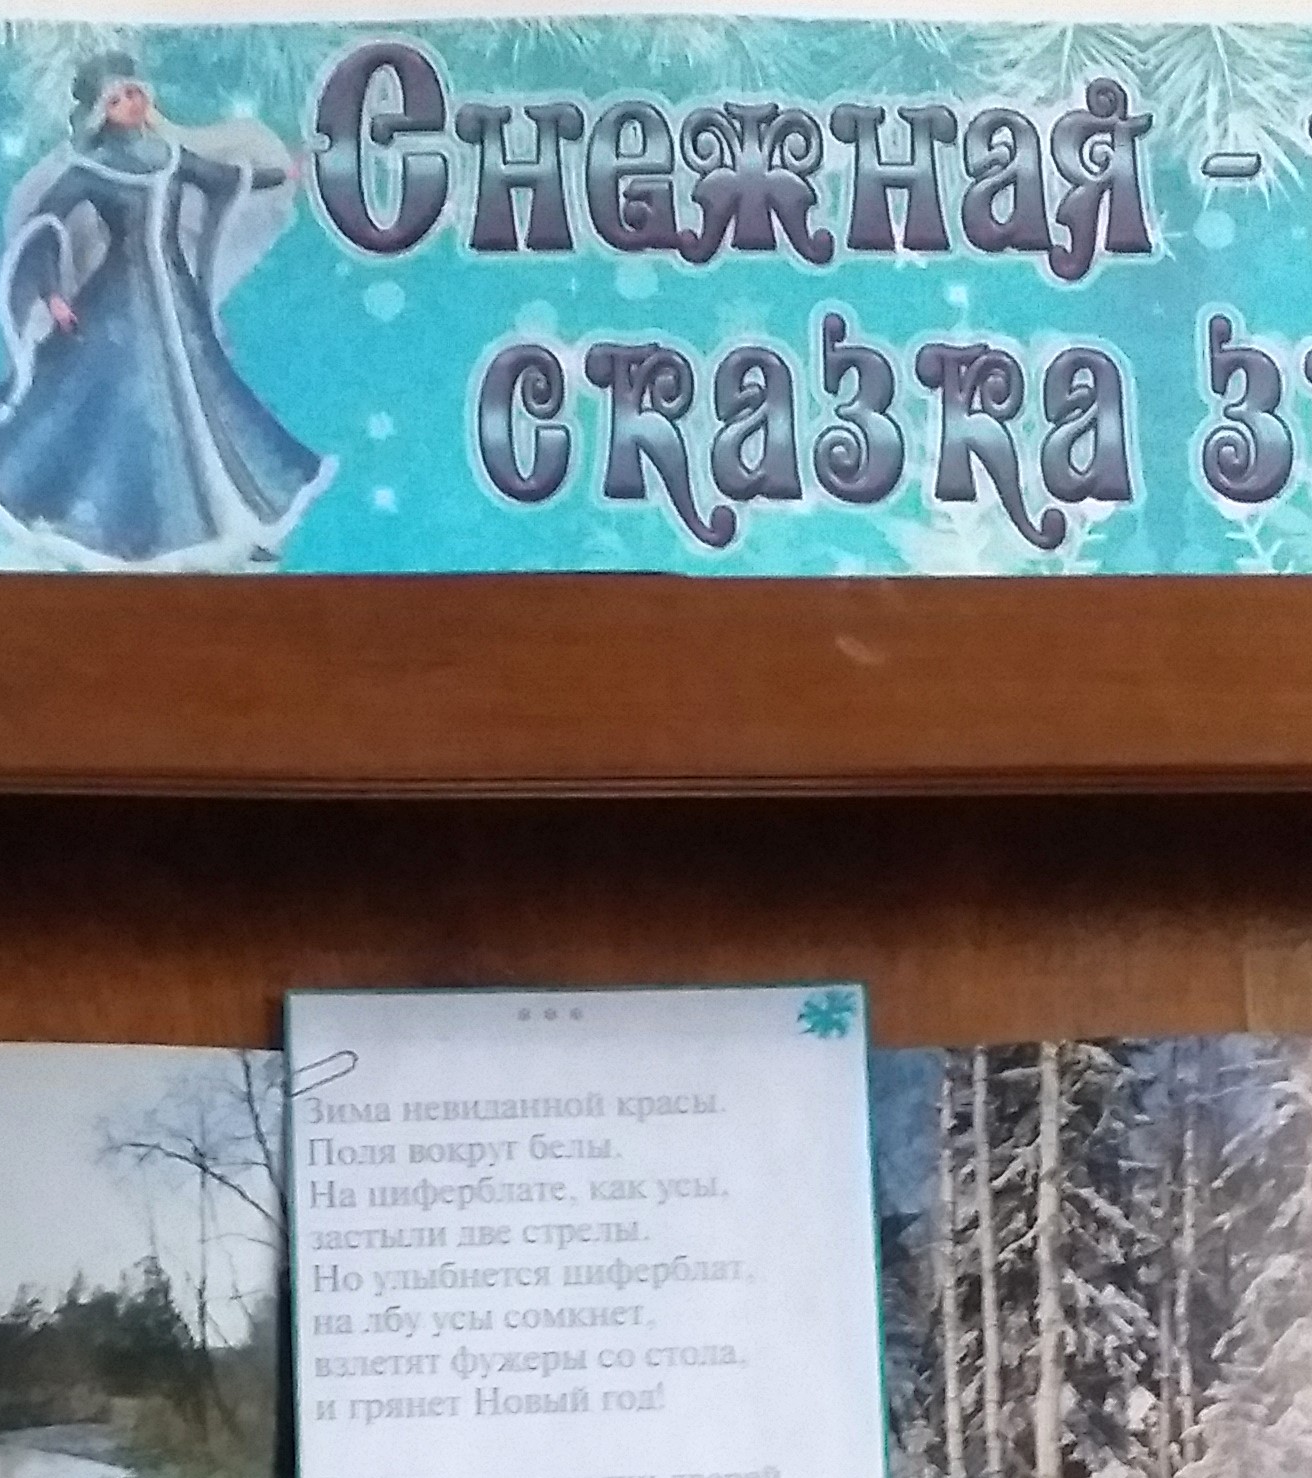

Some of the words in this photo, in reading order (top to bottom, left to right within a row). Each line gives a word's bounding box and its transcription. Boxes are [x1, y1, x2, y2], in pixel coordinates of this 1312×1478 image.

[304, 1096, 393, 1125] Зима
[401, 1092, 606, 1122] невиданной
[307, 1138, 398, 1168] Поля
[407, 1139, 521, 1168] вокруг
[309, 1181, 358, 1211] На
[587, 1176, 650, 1203] как
[309, 1226, 448, 1251] застыли
[455, 1222, 515, 1248] две
[312, 1265, 365, 1295] Но
[371, 1261, 552, 1294] улыбнется
[312, 1311, 356, 1337] на
[359, 1307, 423, 1340] лбу
[430, 1307, 495, 1338] усы
[314, 1353, 443, 1378] взлетят
[448, 1344, 589, 1377] фужеры
[595, 1345, 638, 1371] со
[314, 1397, 339, 1423] и
[347, 1394, 463, 1424] грянет
[473, 1387, 594, 1417] Новый
[600, 1384, 667, 1414] год!
